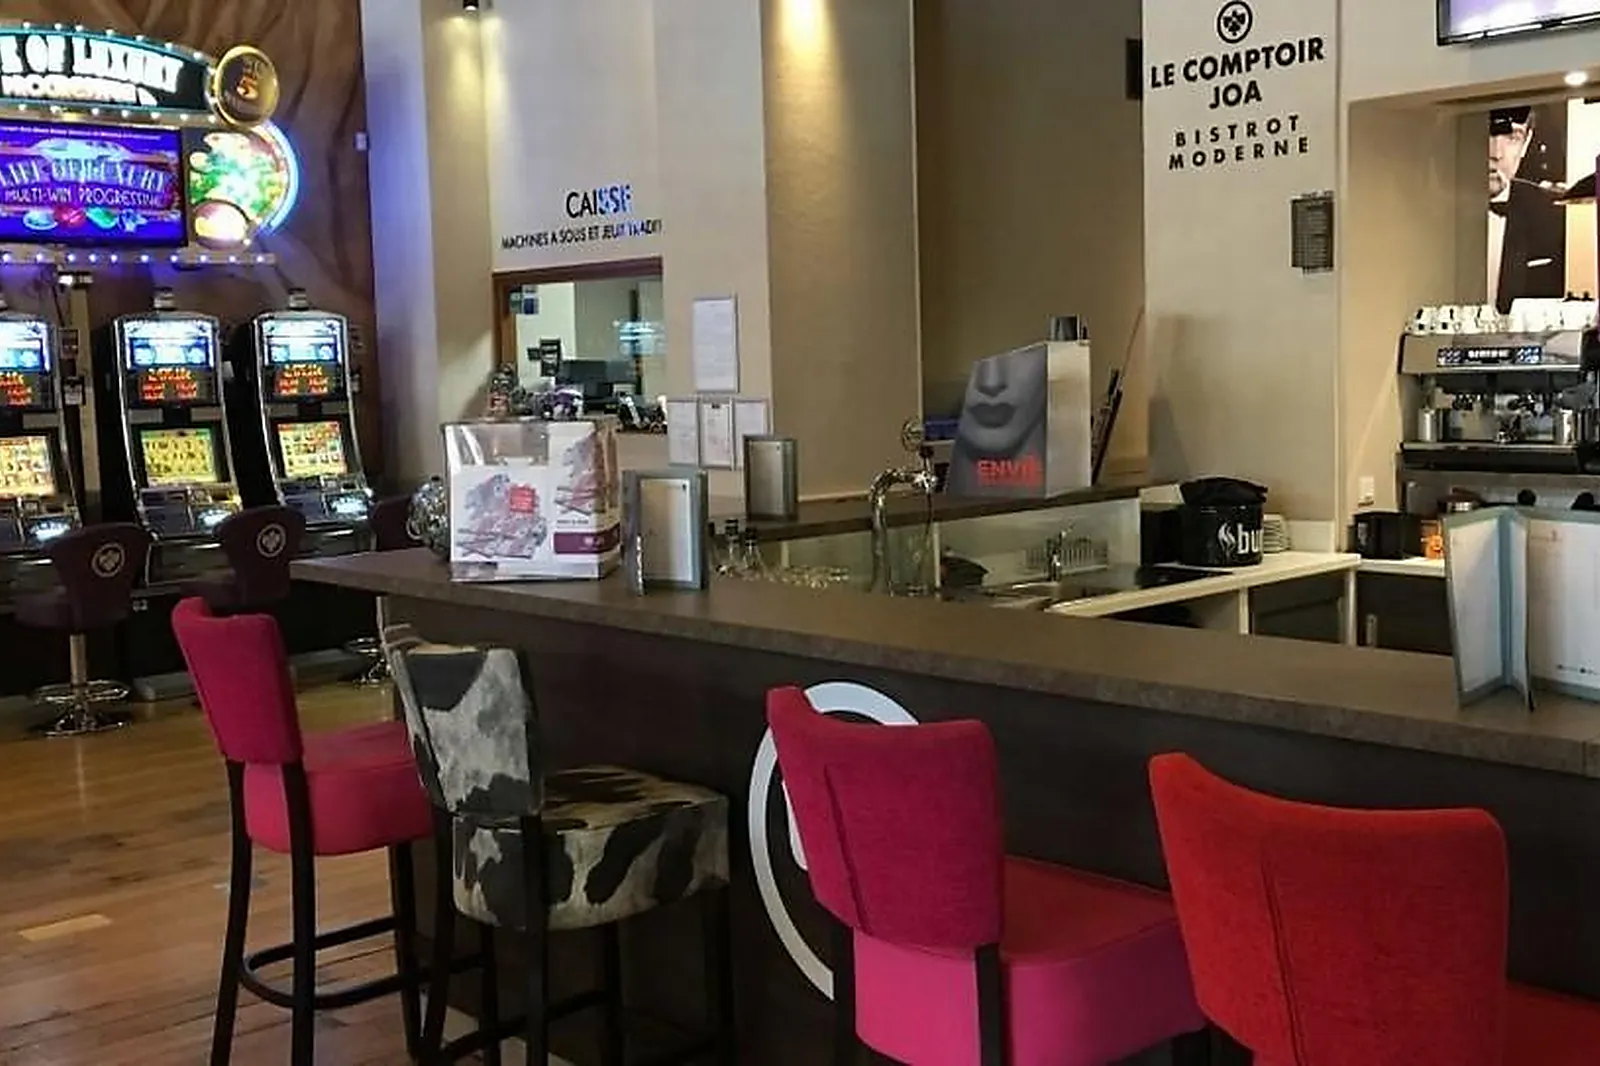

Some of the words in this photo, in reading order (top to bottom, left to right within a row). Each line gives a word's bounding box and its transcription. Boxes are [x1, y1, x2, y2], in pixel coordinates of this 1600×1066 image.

[1151, 63, 1175, 88] LE
[1183, 36, 1324, 82] COMPTOIR
[1209, 80, 1263, 109] JOA
[1175, 114, 1299, 147] BISTROT
[1169, 136, 1309, 170] MODERNE
[501, 231, 549, 250] MACHINES
[559, 226, 587, 244] SOUS
[588, 224, 600, 240] ET
